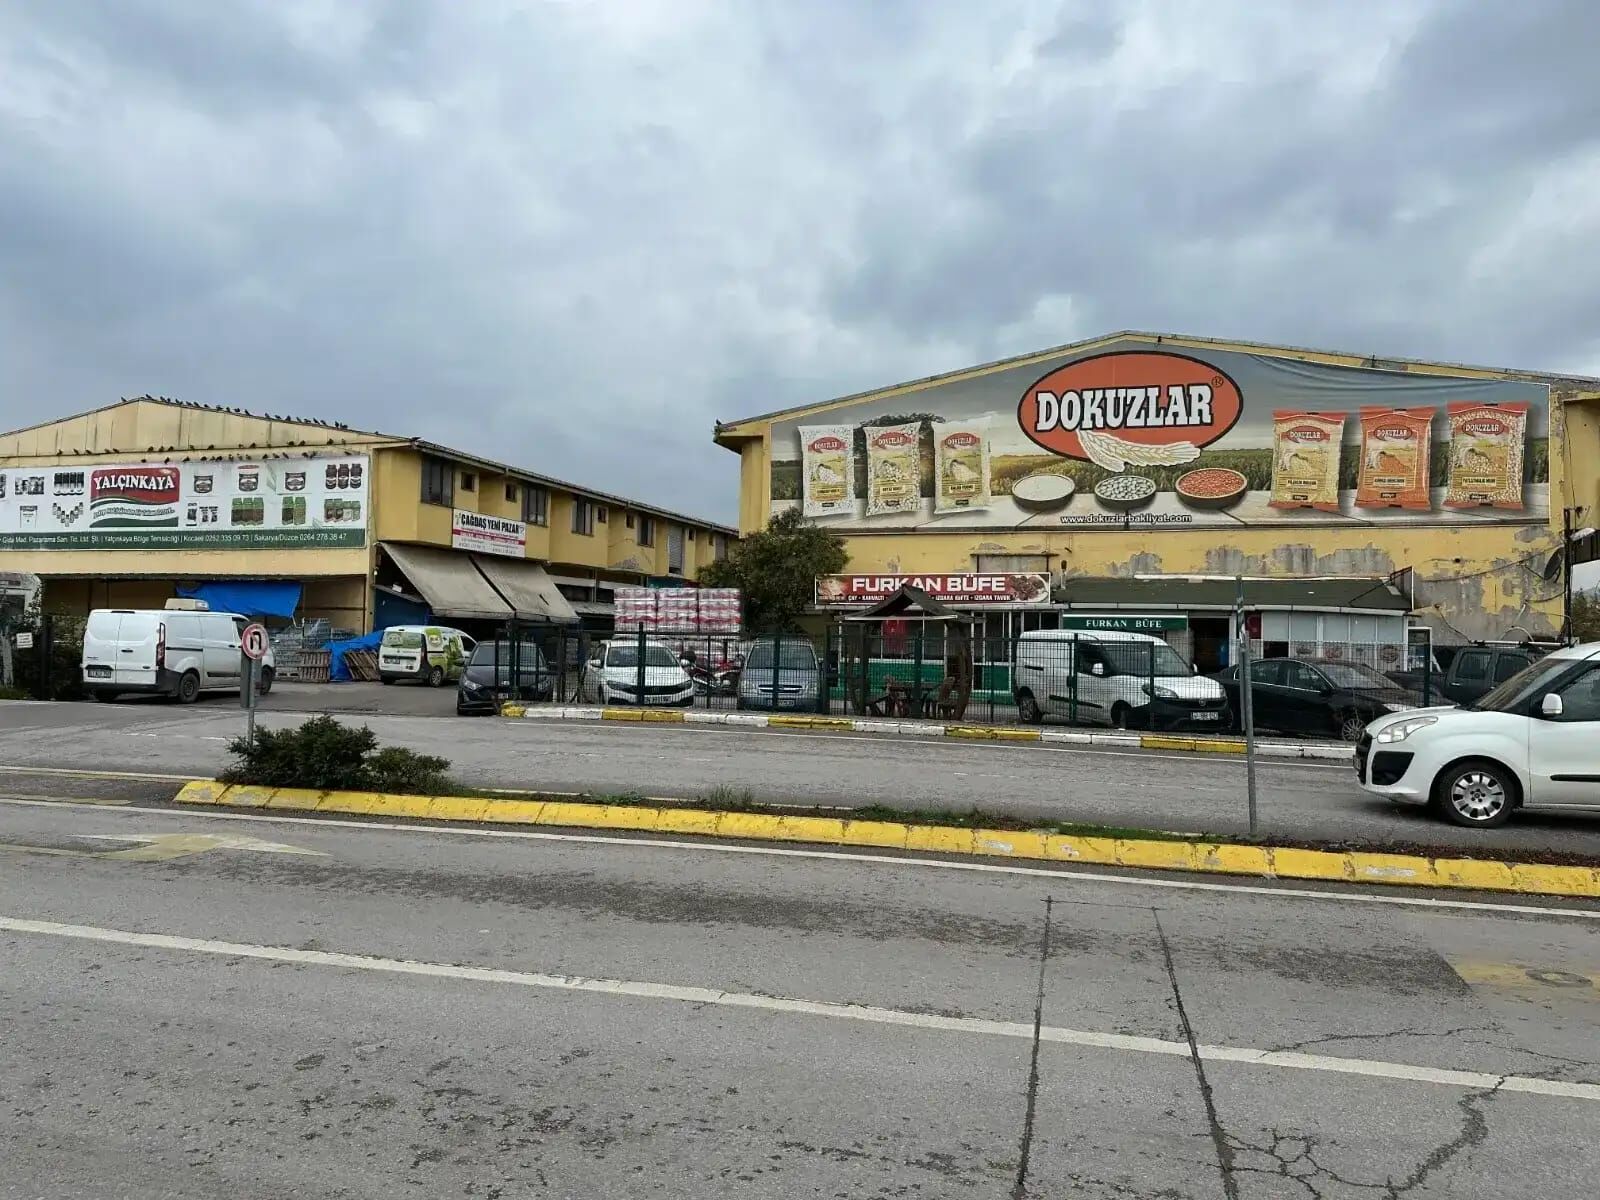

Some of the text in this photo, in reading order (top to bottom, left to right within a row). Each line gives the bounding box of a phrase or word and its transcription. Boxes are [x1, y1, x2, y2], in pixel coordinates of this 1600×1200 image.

[1036, 384, 1213, 432] DOKUZLAR
[1465, 423, 1500, 432] DOKUZLAR
[1290, 431, 1321, 439] DOKUZLAR
[93, 474, 175, 490] YALÇINKAYA
[461, 513, 487, 530] ÇAĞDAŞ
[487, 518, 500, 530] YENİ
[1060, 513, 1193, 526] www.dokuzlarbakliyat.com
[852, 574, 1006, 592] FURKAN BÜFE
[1086, 618, 1162, 628] FURKAN BÜFE
